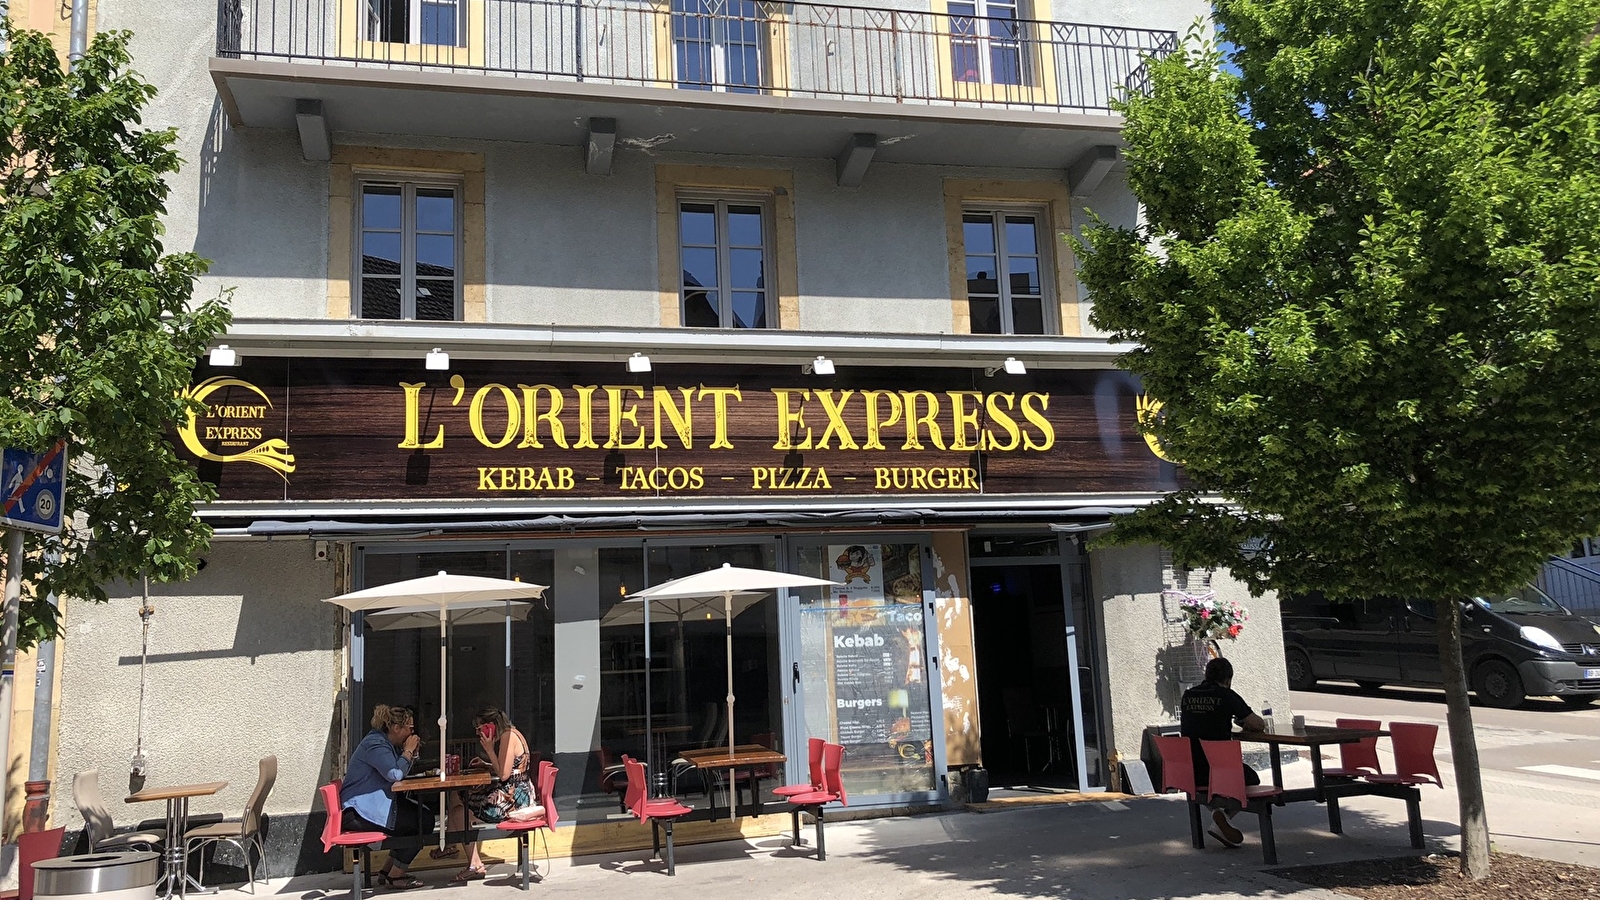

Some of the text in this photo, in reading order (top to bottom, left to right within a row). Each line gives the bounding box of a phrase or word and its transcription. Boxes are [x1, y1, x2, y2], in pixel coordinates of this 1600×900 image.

[206, 404, 267, 419] L'ORIENT
[398, 375, 1055, 451] L'ORIENT EXPRESS
[205, 426, 262, 440] EXPRESS
[477, 467, 575, 490] KEBAB
[616, 466, 704, 490] TACOS
[751, 467, 832, 489] PIZZA
[874, 467, 979, 490] BURGER
[40, 498, 51, 510] 20
[834, 634, 884, 648] Kebab
[837, 698, 882, 709] Burgers
